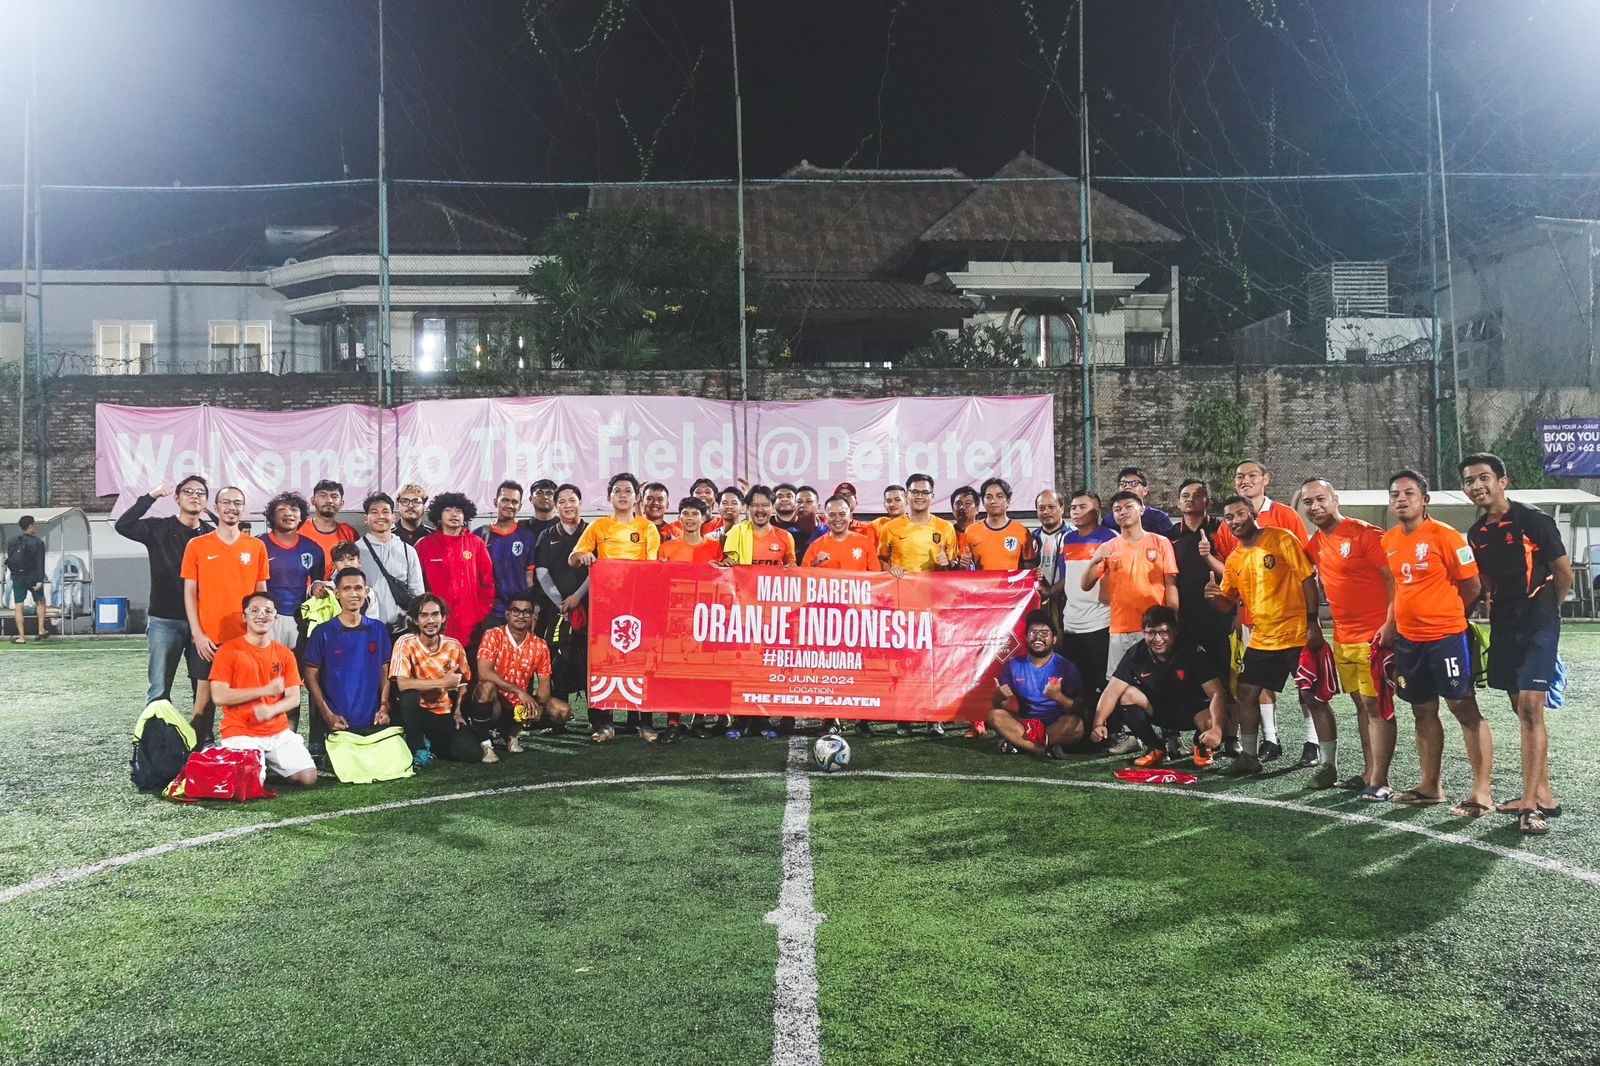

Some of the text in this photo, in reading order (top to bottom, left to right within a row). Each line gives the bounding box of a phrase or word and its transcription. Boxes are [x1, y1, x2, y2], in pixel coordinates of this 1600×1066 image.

[1544, 432, 1575, 442] BOOK
[1544, 443, 1563, 452] VIA
[1578, 443, 1594, 452] +62
[117, 422, 1034, 492] Welcome to The Field @Pejaten
[1401, 562, 1413, 584] 9
[757, 575, 872, 605] MAIN BARENG
[692, 602, 933, 650] ORANJE INDONESIA
[762, 648, 863, 671] #BELANDAJUARA
[1444, 656, 1460, 678] 15
[768, 674, 856, 685] 20 JUNI 2024
[742, 693, 881, 708] THE FIELD PEJATEN
[789, 687, 835, 695] LOCATION
